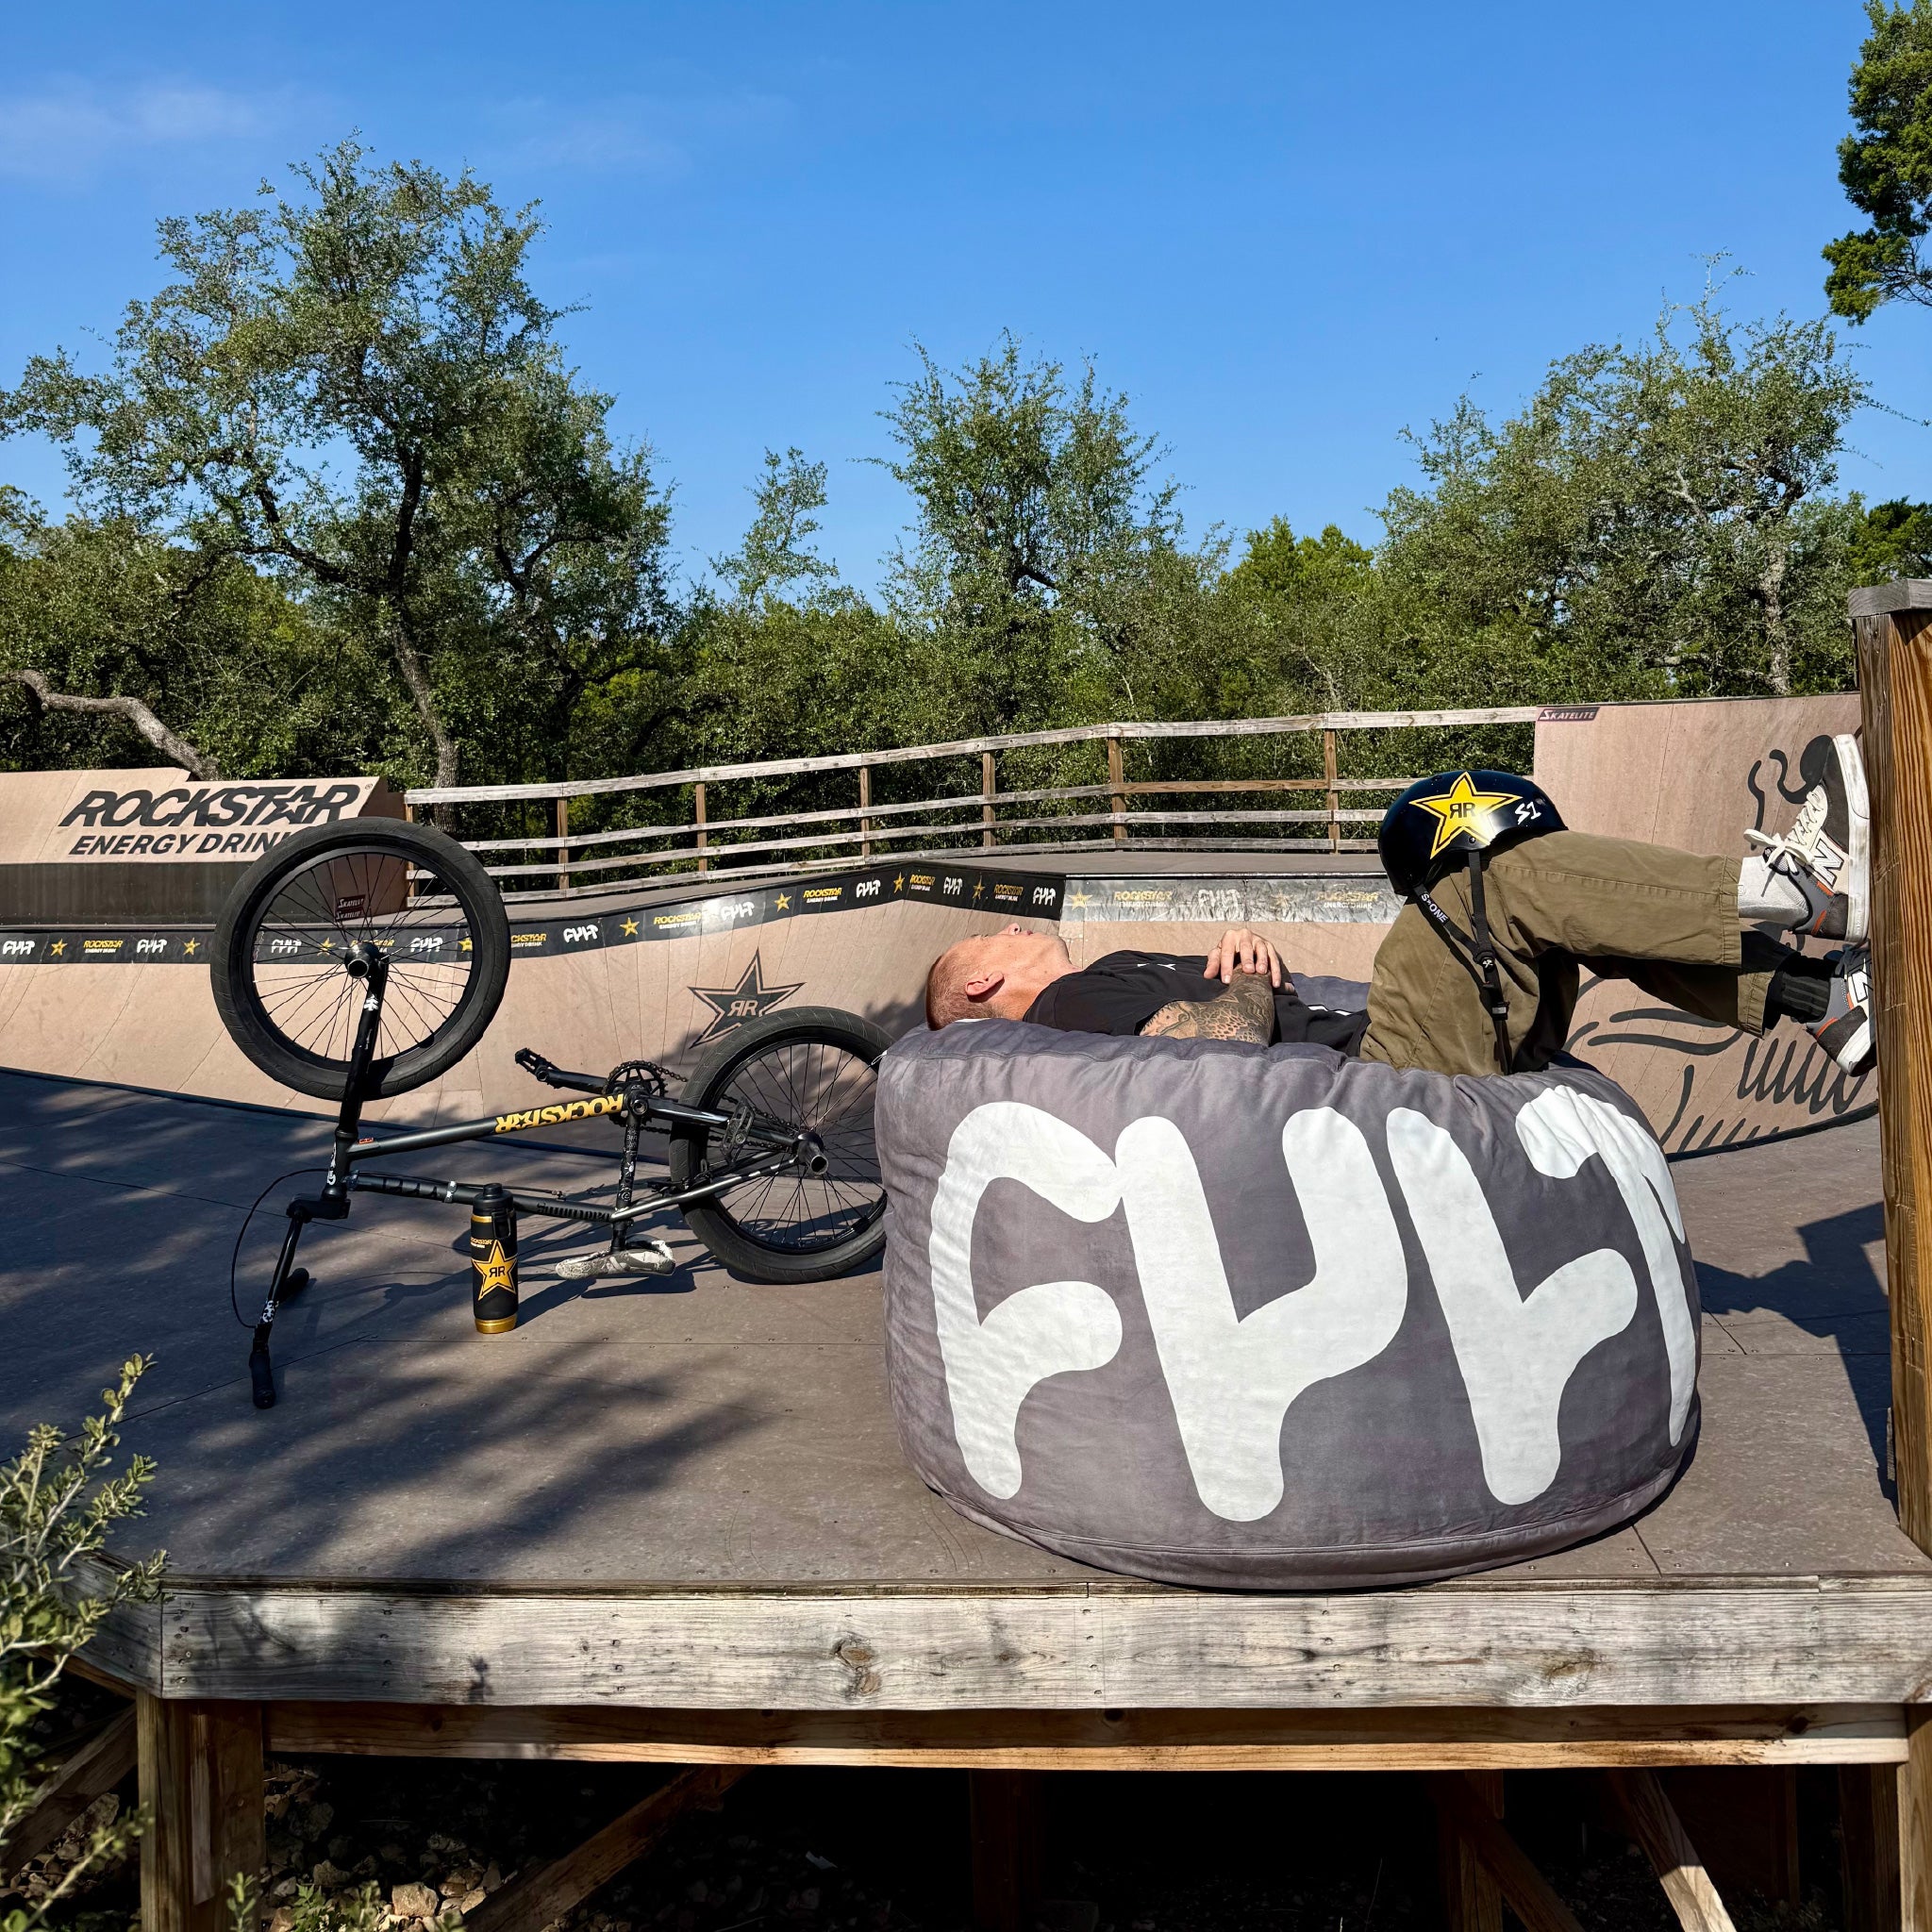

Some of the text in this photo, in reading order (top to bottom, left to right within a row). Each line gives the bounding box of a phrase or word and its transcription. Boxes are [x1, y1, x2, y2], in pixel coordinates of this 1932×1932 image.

[58, 784, 360, 828] ROCKSTAR
[68, 832, 291, 856] ENERGY DRIN
[804, 888, 842, 898] ROCKSTAR
[511, 933, 547, 942] CKSTAR
[563, 924, 599, 943] CULT
[2, 940, 36, 956] CULT
[83, 939, 124, 948] ROCKSTAR
[136, 939, 168, 954] CULT
[494, 1093, 625, 1134] ROCKSTAR
